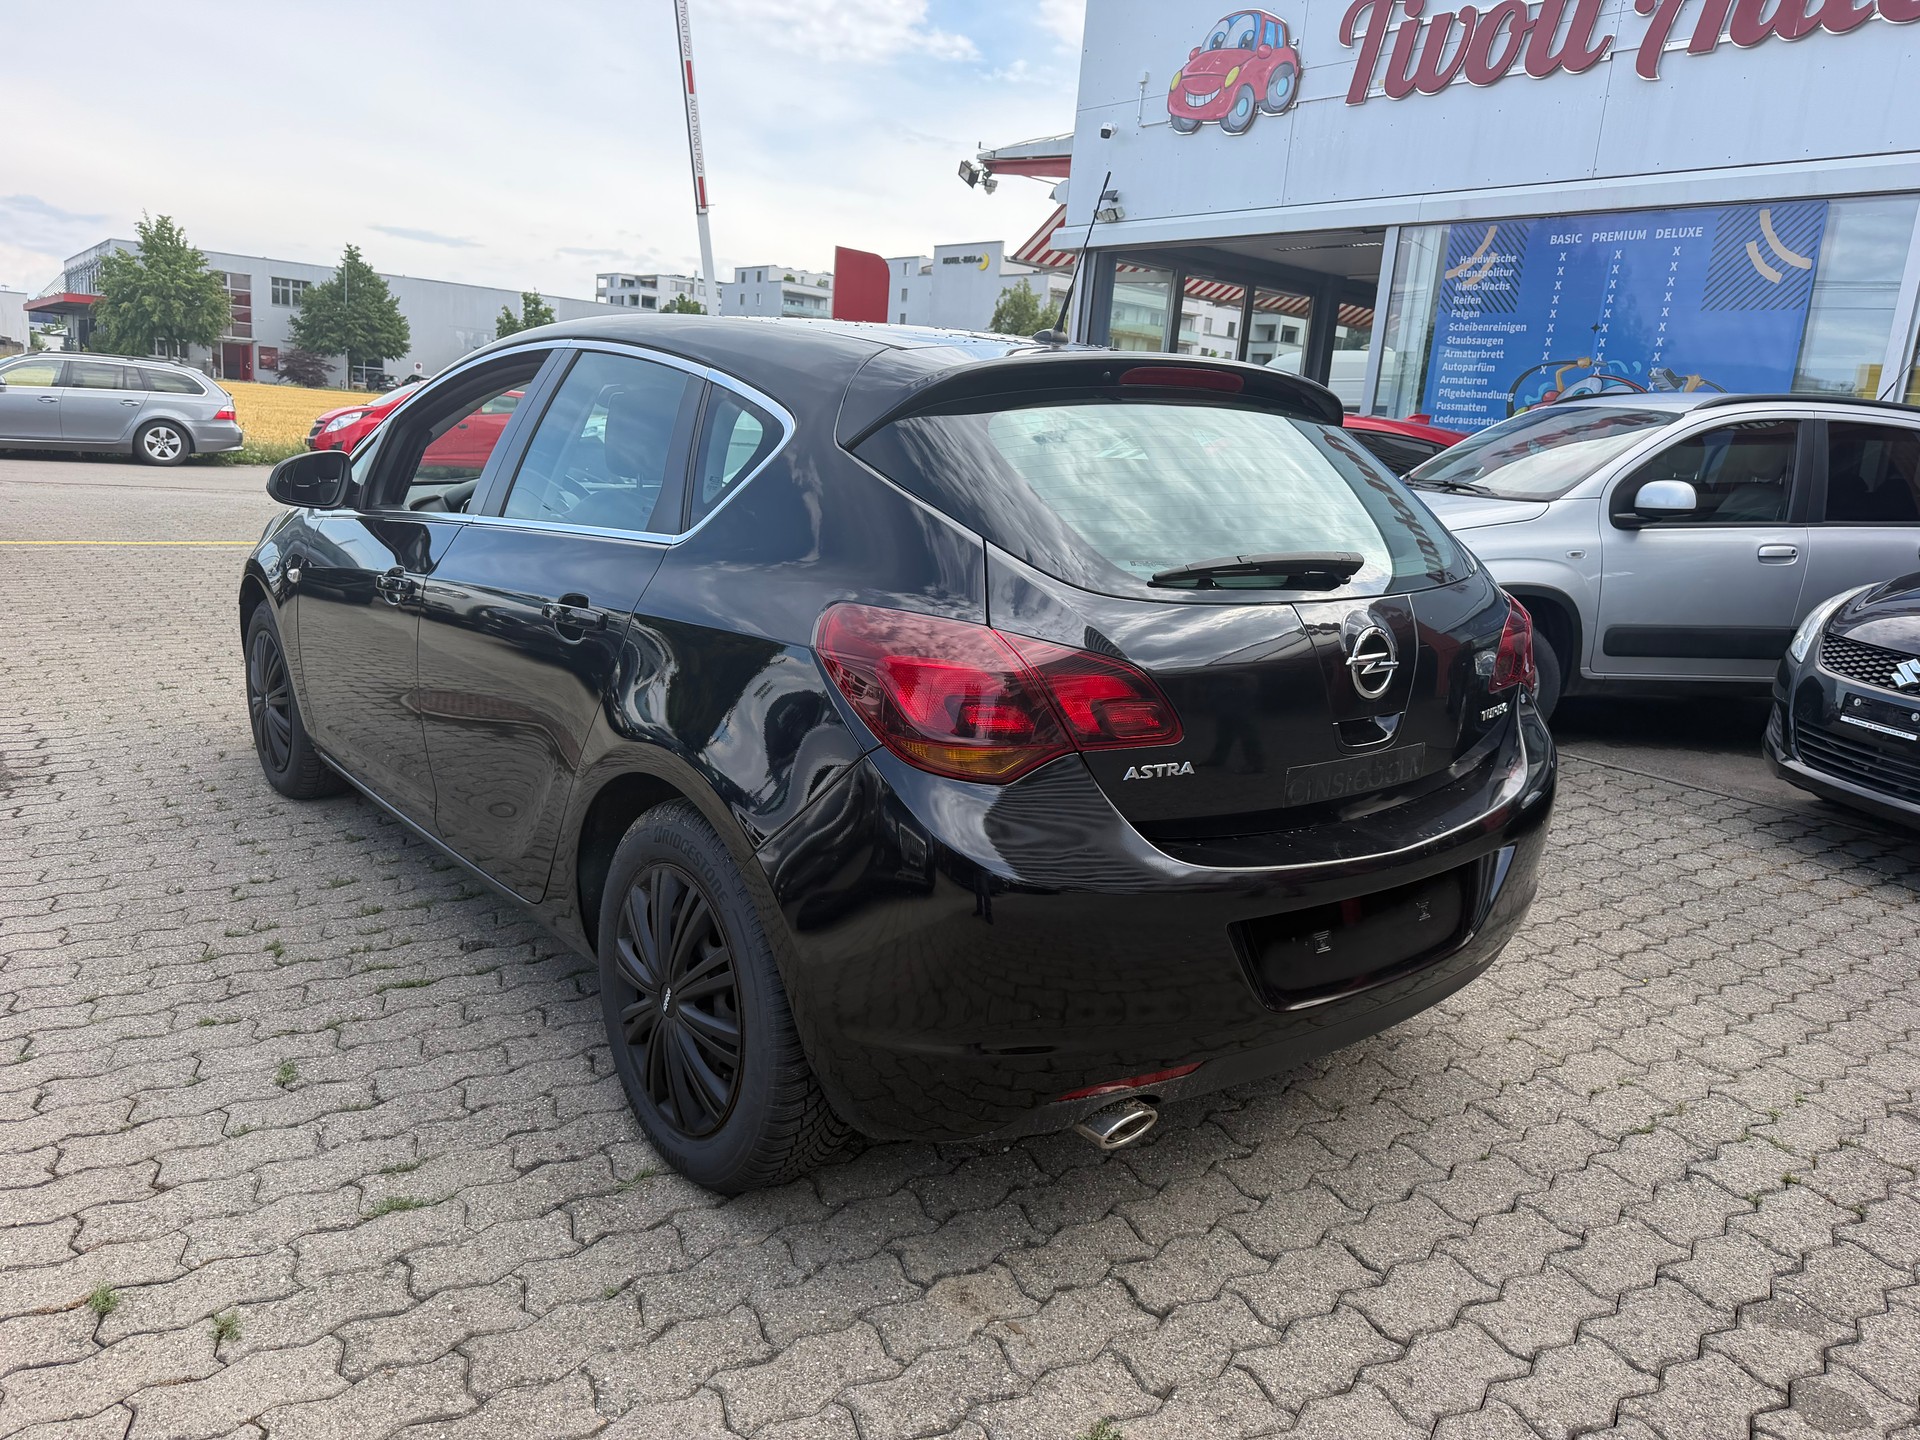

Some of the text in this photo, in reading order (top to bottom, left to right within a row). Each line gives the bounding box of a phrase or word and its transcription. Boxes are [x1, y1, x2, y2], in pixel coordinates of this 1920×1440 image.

[680, 4, 688, 33] TIVOLI
[689, 98, 703, 173] AUTO TIVOLI PIZZI
[1550, 226, 1703, 245] BASIC PREMIUM DELUXE
[1457, 268, 1514, 278] Glanzpolitur
[1455, 281, 1510, 291] Nano-Wachs
[1453, 295, 1481, 305] Reifen
[1451, 309, 1480, 320] Felgen
[1449, 321, 1527, 334] Scheibenreinigen
[1446, 335, 1504, 347] Staubsaugen
[1444, 349, 1504, 359] Armaturbrett
[1442, 362, 1496, 373] Autoparfüm
[1440, 375, 1488, 385] Armaturen
[1436, 401, 1487, 412] Fussmatten
[1434, 414, 1502, 426] Lederausstattu
[1123, 761, 1195, 780] ASTRA
